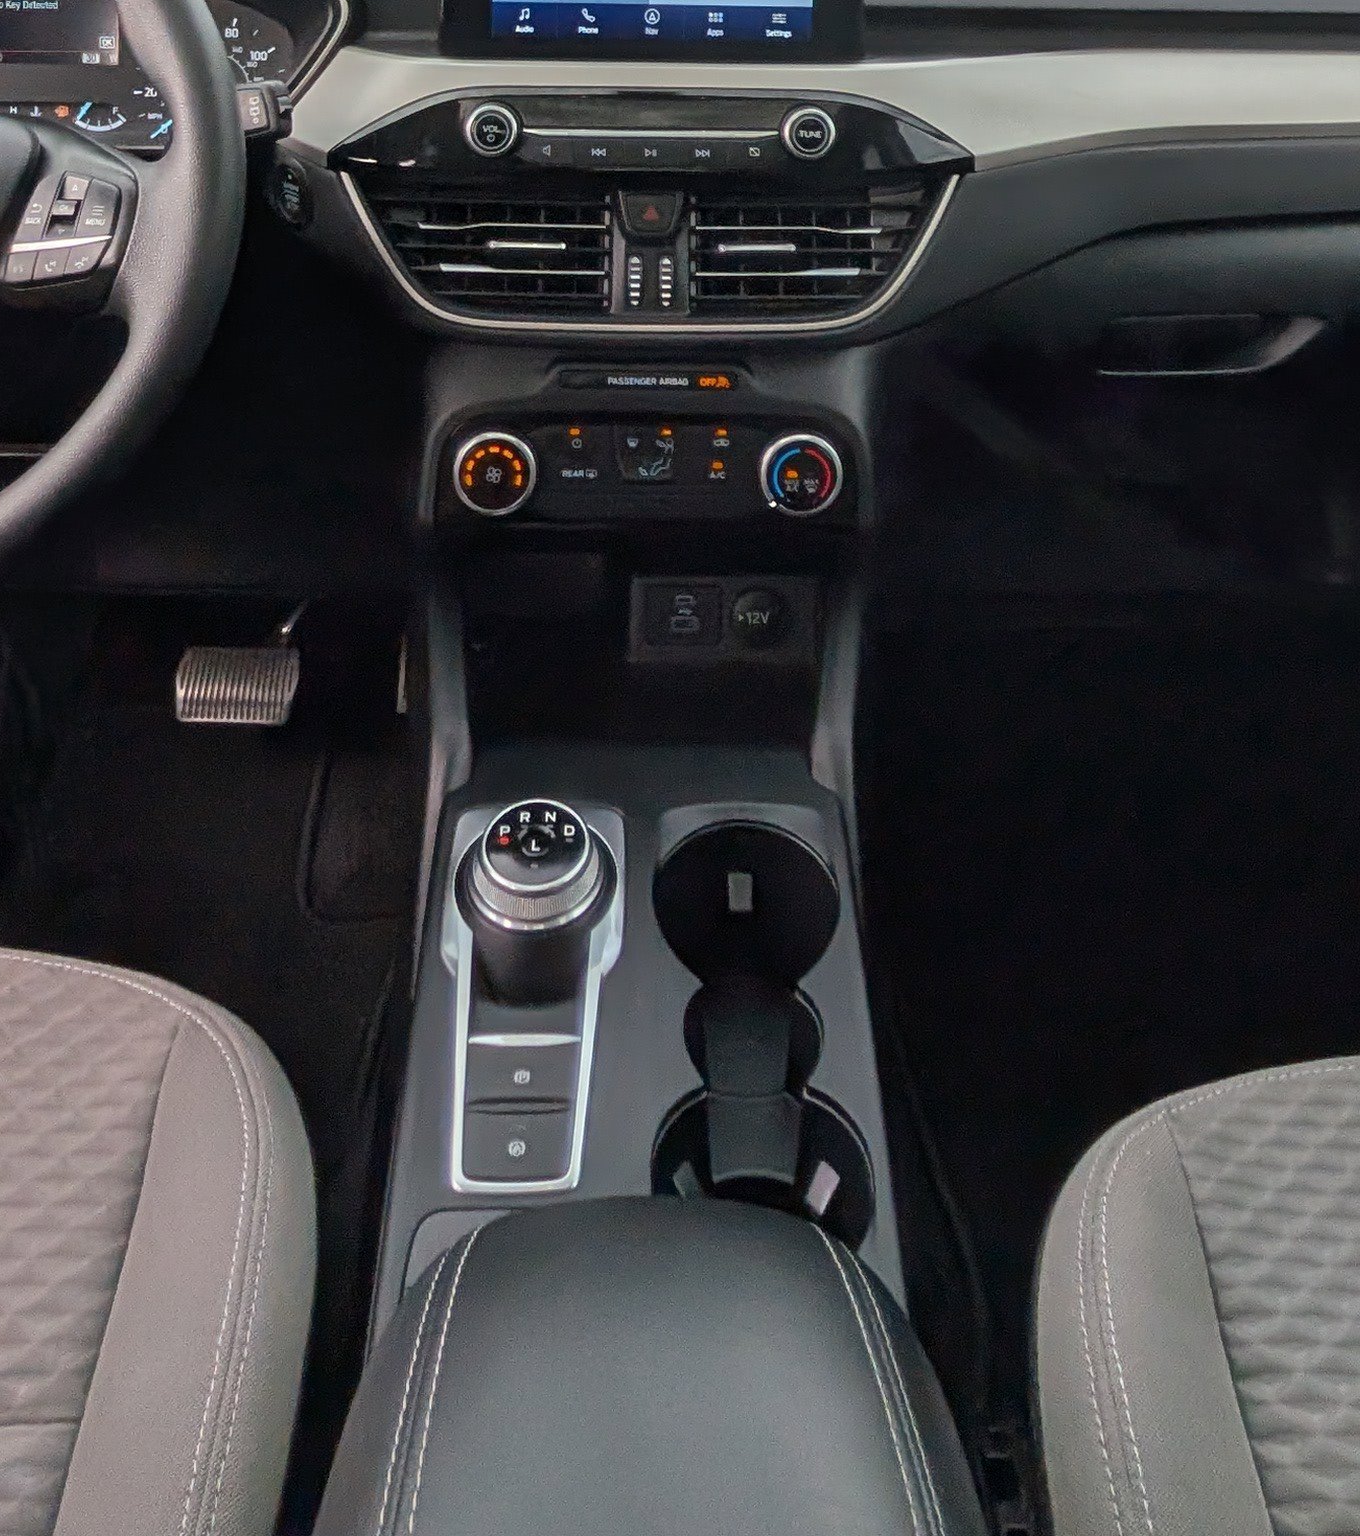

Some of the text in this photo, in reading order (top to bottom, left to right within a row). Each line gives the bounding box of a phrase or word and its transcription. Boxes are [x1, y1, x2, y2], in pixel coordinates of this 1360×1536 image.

[5, 0, 20, 10] Key
[22, 1, 59, 10] Detected
[224, 27, 239, 38] 80
[515, 25, 534, 33] Audio
[578, 26, 598, 34] Phone
[707, 28, 724, 37] Apps
[765, 29, 792, 38] Settings
[249, 51, 268, 61] 100
[112, 106, 119, 114] F
[798, 129, 822, 139] TUNE
[608, 377, 689, 386] PASSENGER AIRBAG
[699, 378, 717, 386] OFF
[562, 470, 584, 478] REAR
[746, 612, 769, 624] 12V
[520, 811, 530, 823] R
[545, 811, 557, 823] N
[500, 825, 511, 836] P
[564, 824, 575, 836] D
[531, 839, 540, 851] L
